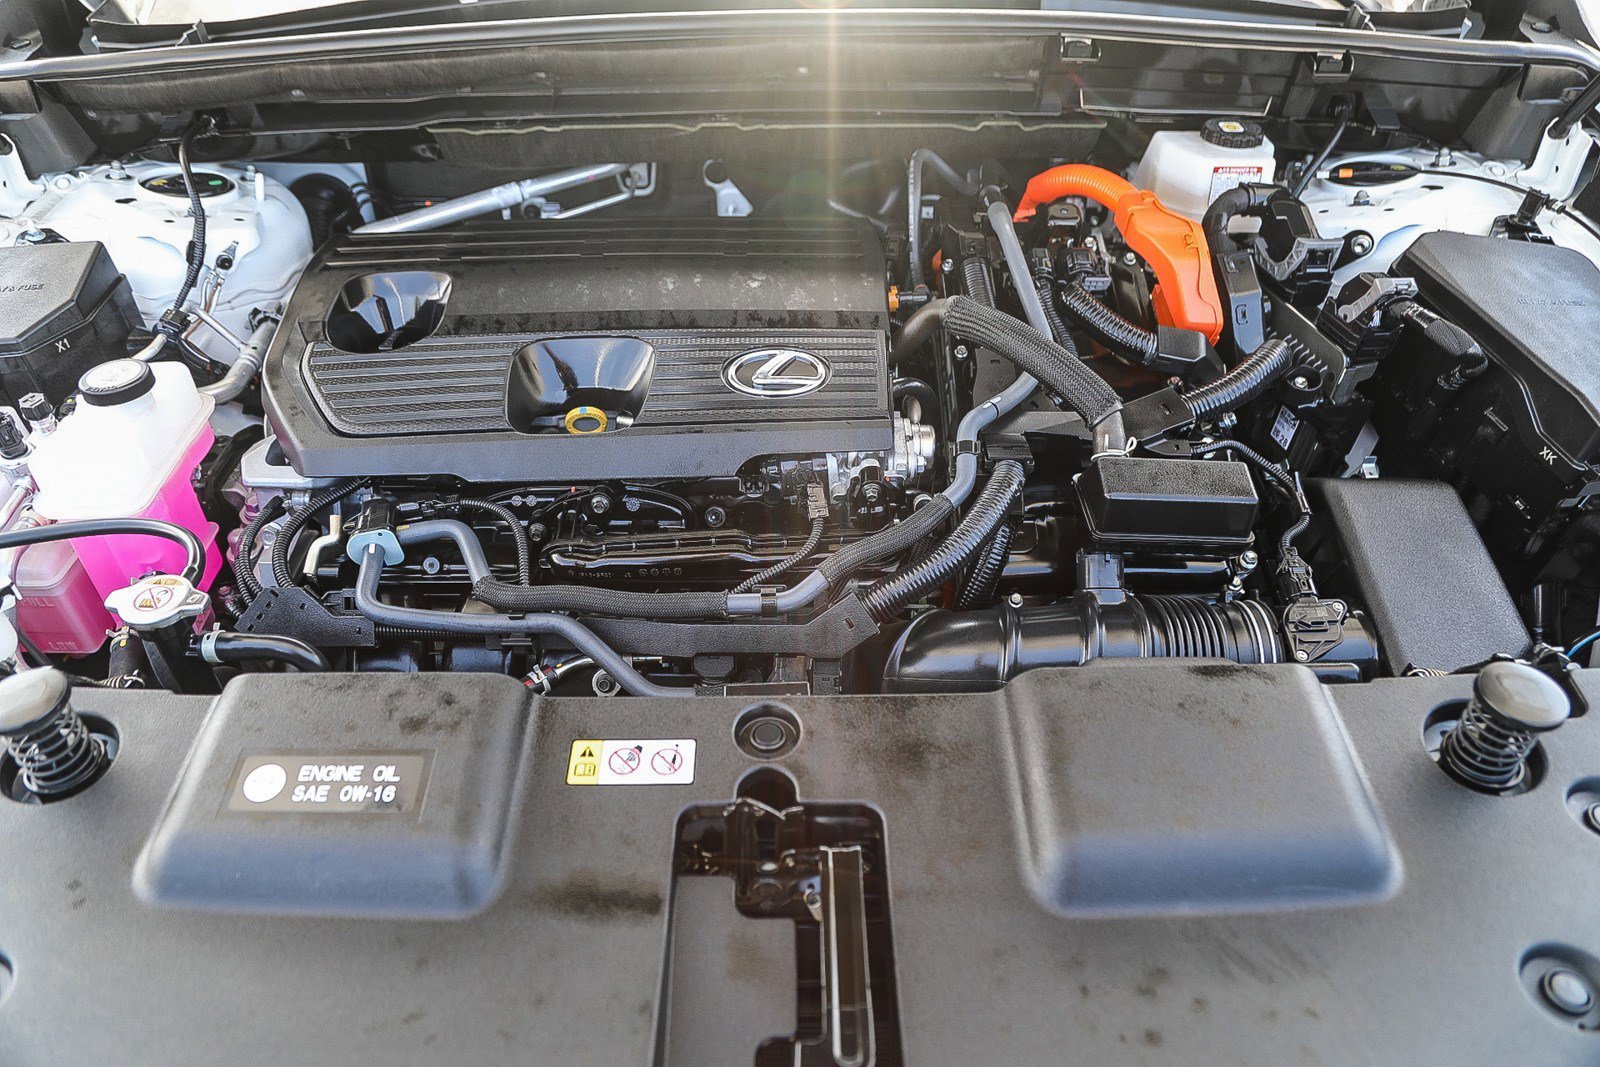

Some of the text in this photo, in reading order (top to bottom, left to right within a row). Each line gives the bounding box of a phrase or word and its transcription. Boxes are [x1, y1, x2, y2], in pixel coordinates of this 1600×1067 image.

[17, 283, 45, 292] FUSE
[54, 338, 71, 353] X1
[1539, 446, 1558, 465] XK
[48, 641, 77, 651] LOW
[297, 764, 401, 782] ENGINE OIL
[291, 784, 398, 803] SAE 0W-16
